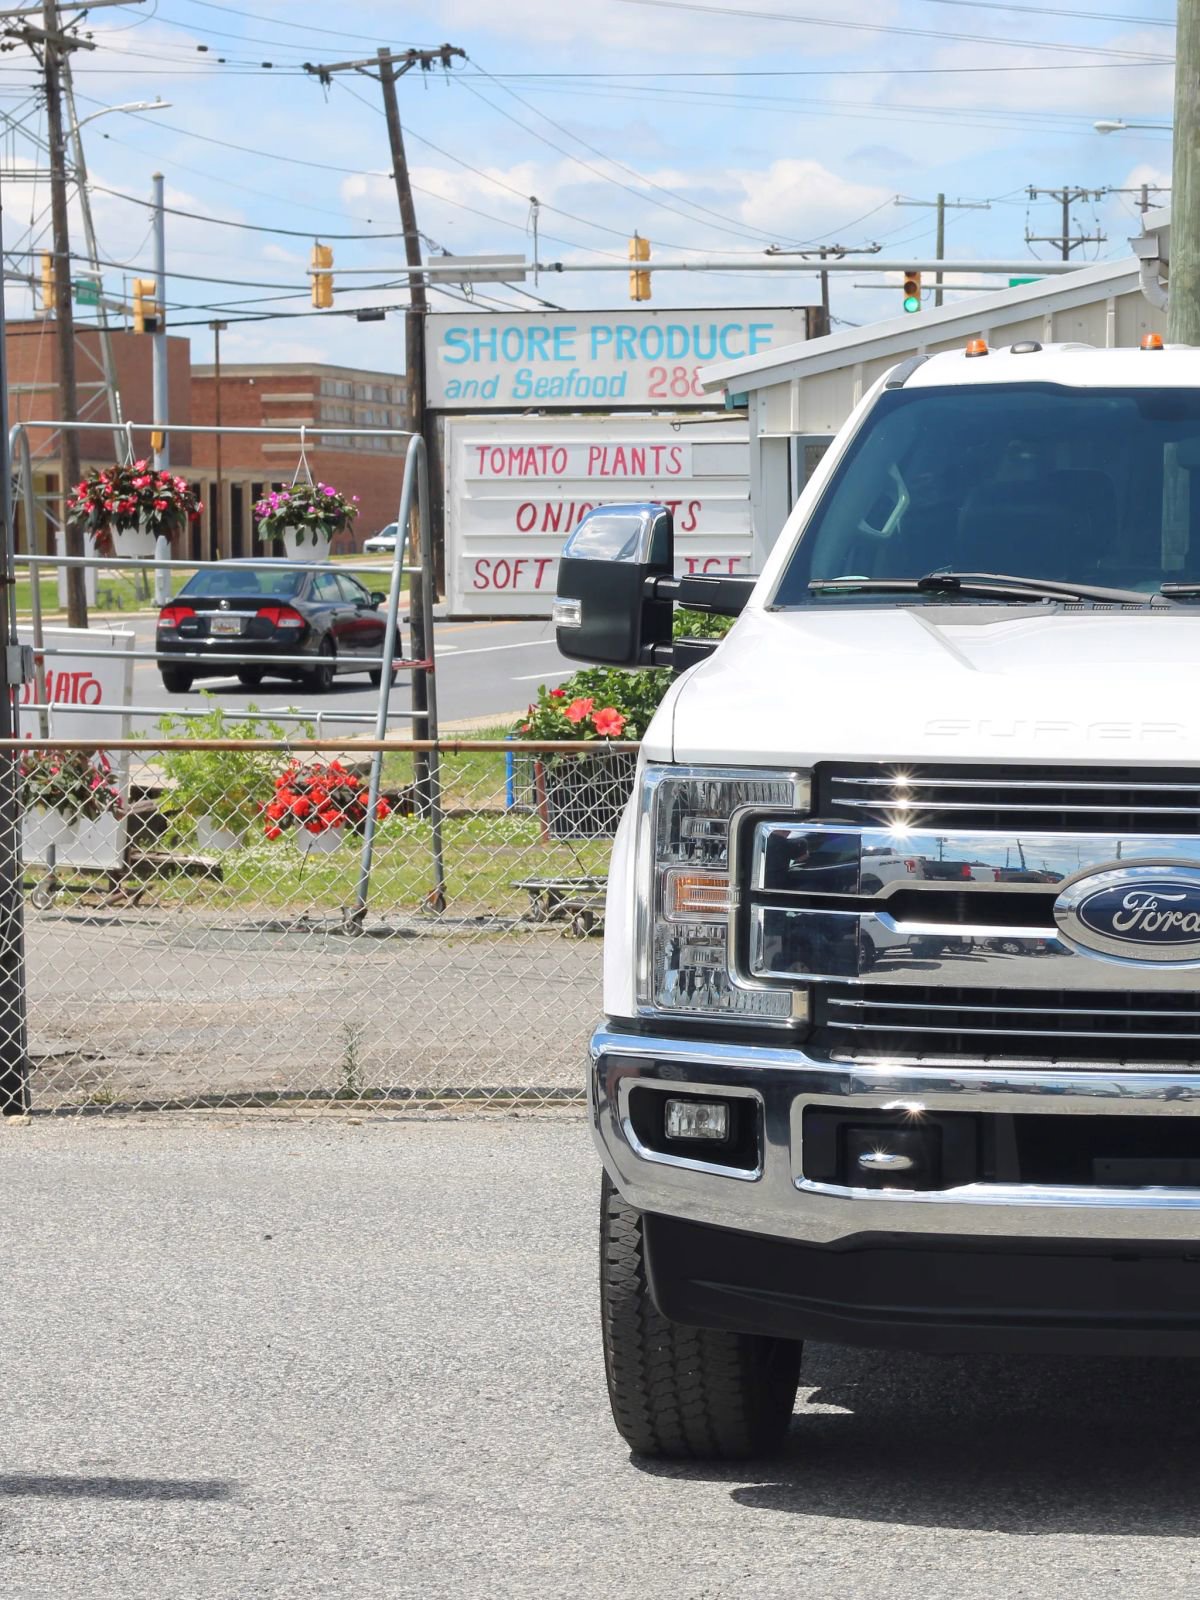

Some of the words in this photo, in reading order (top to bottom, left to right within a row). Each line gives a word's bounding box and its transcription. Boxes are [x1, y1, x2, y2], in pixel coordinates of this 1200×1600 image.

[443, 325, 577, 364] SHORE
[591, 323, 774, 360] PRODUCE
[444, 374, 500, 400] and
[511, 367, 627, 399] Seafood
[476, 445, 568, 476] TOMATO
[588, 446, 683, 476] PLANTS
[473, 558, 552, 590] SOFT
[923, 718, 1187, 741] SUPER
